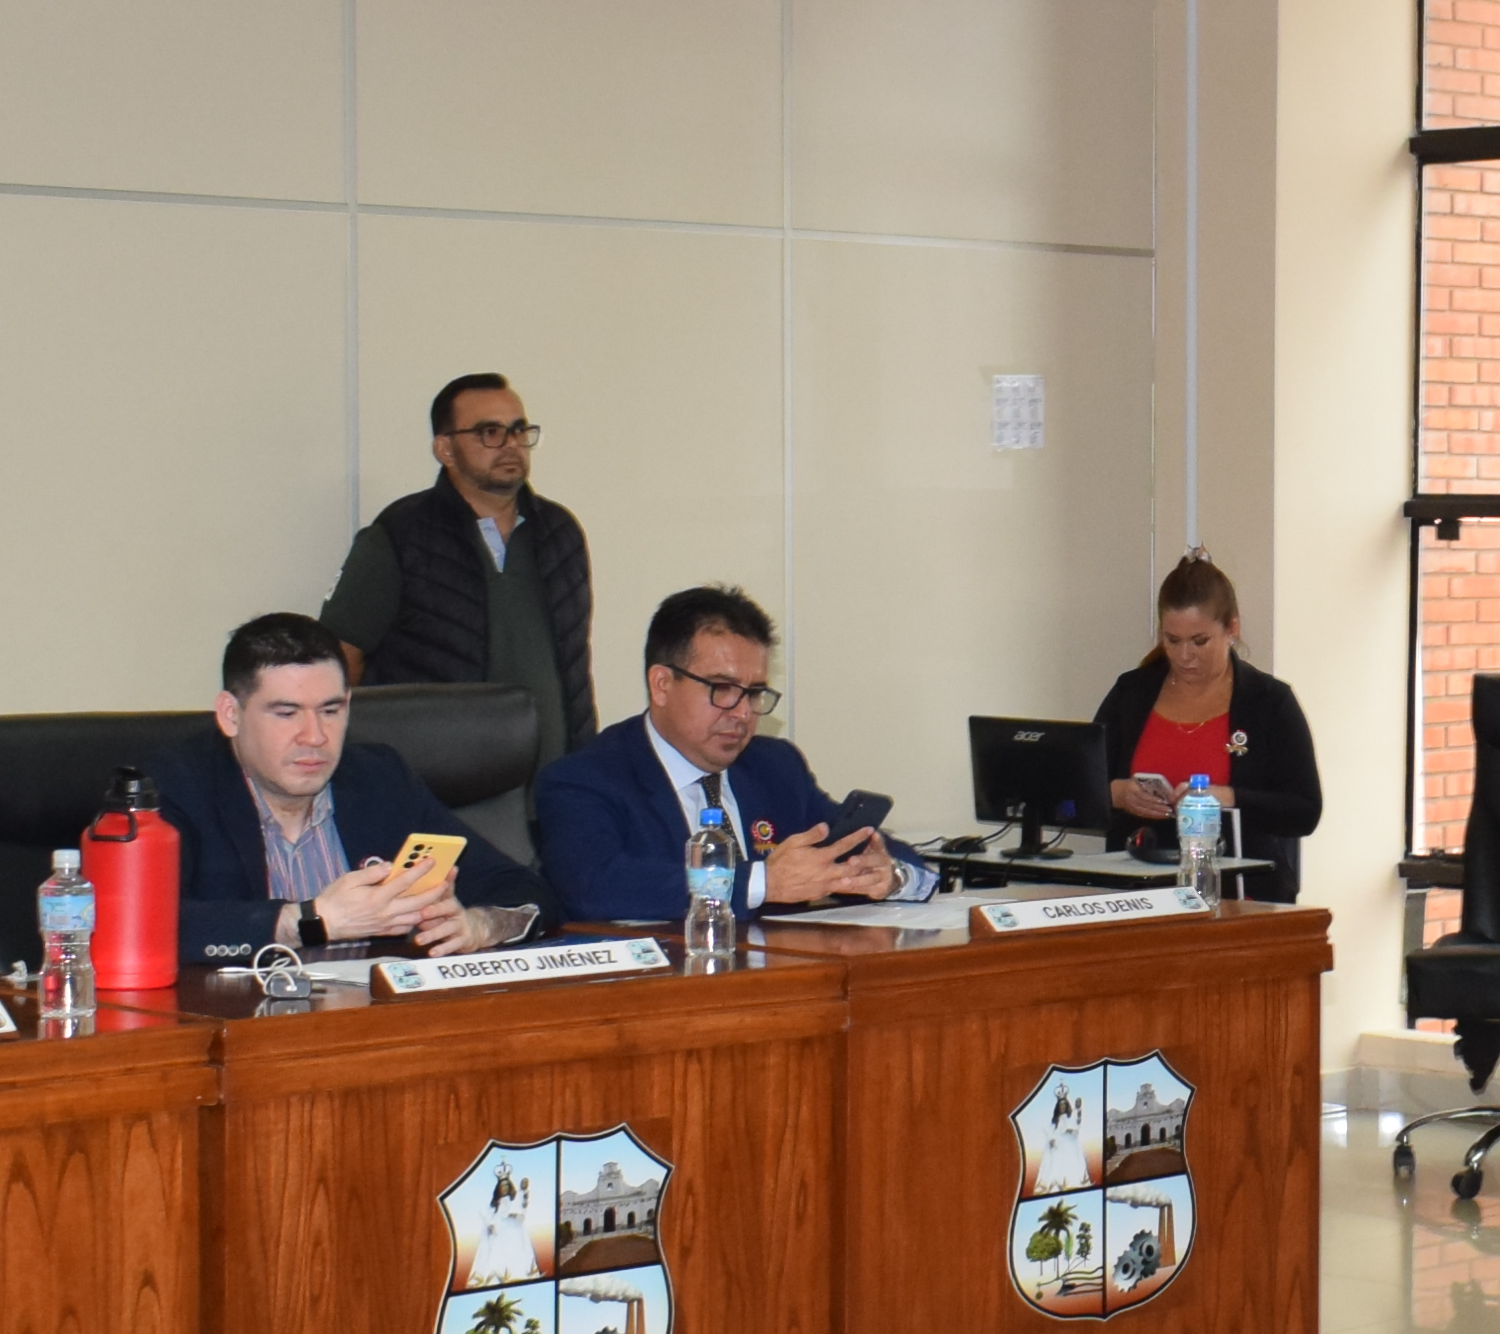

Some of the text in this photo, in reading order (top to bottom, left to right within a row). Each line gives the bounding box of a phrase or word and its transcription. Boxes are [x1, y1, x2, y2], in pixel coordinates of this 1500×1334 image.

[1012, 730, 1046, 742] acer
[1042, 897, 1154, 919] CARLOS DENIS
[437, 949, 618, 980] ROBERTO JIMÉNEZ
